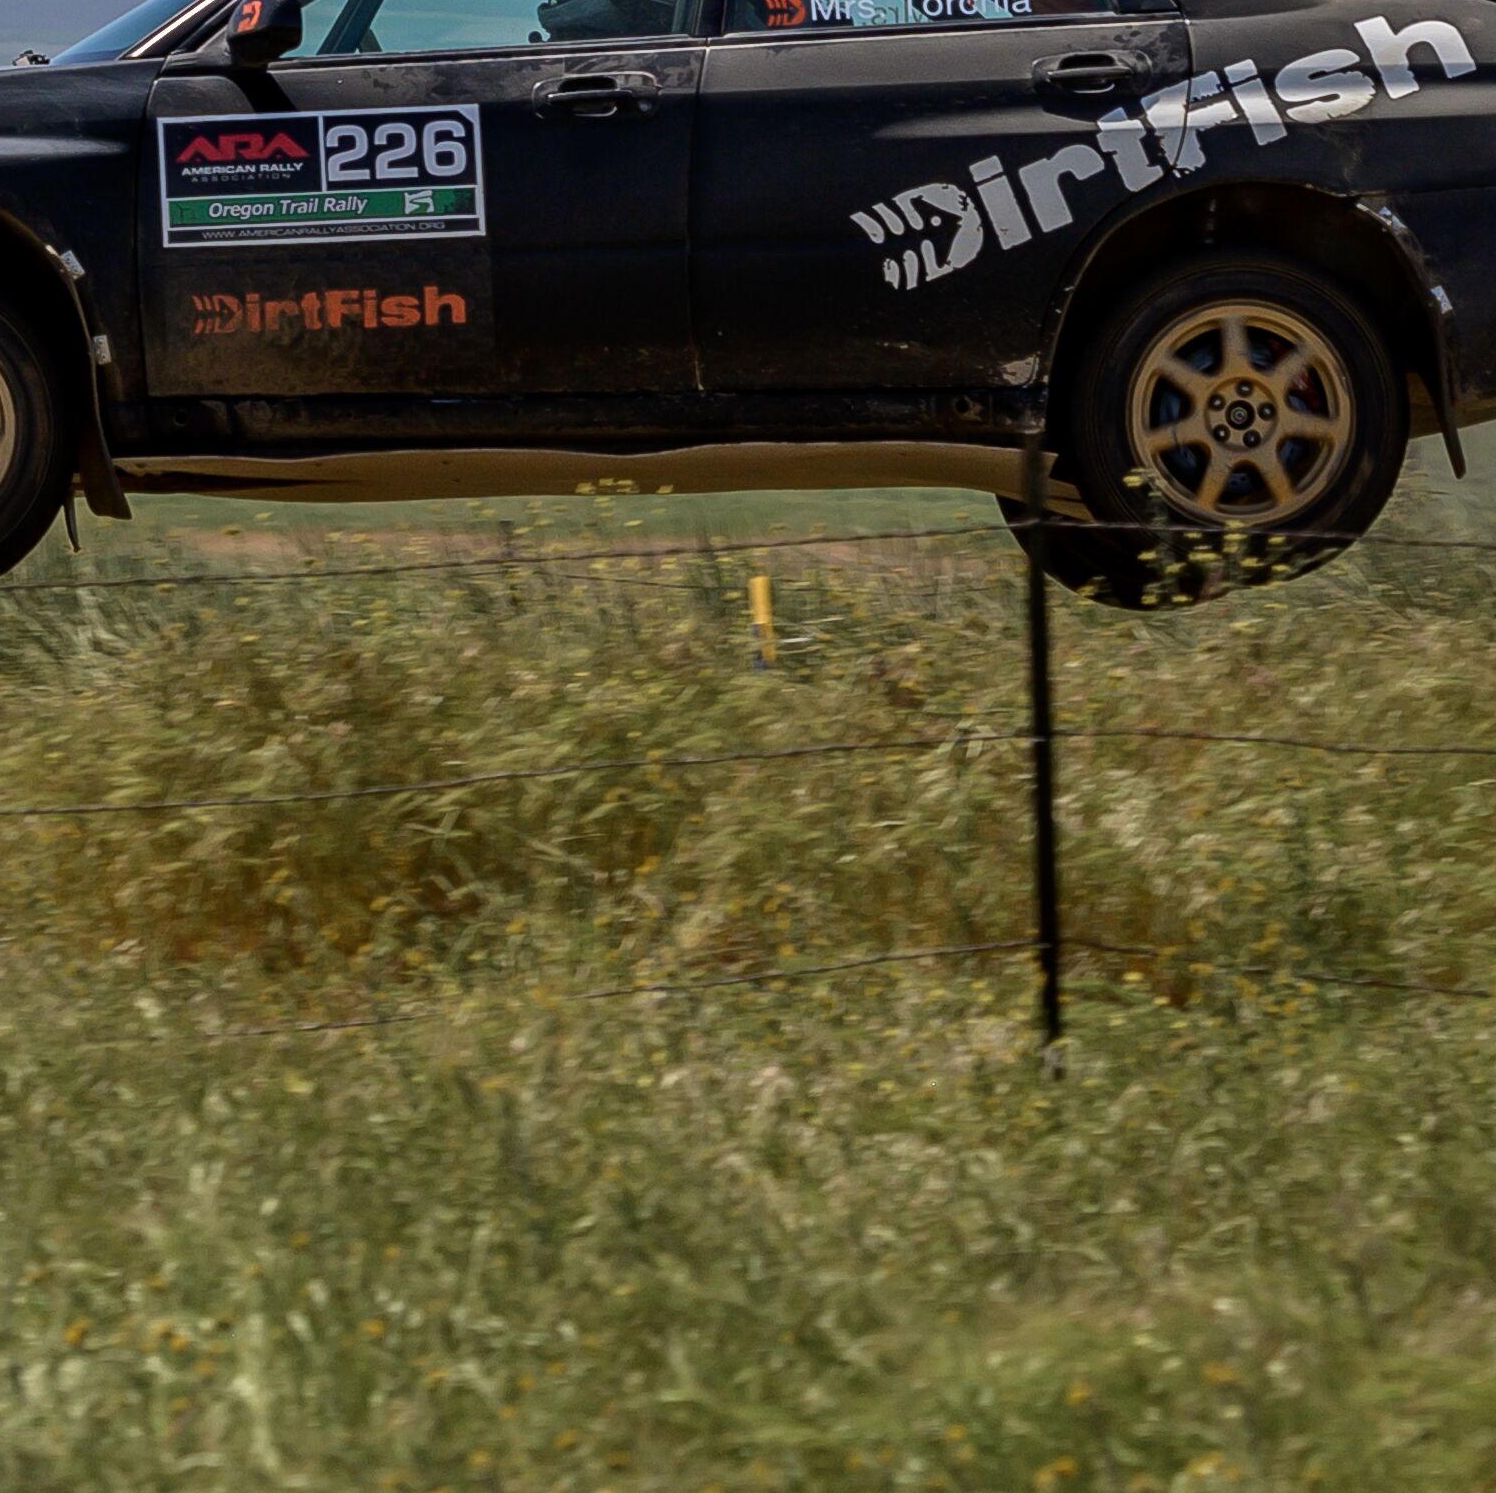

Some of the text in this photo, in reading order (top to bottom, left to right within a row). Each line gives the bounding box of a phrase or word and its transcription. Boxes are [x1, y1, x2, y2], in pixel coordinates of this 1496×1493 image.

[176, 132, 310, 164] ARA
[325, 119, 467, 182] 226
[181, 162, 304, 176] AMERICAN RALLY
[191, 173, 291, 183] ASSOCIATION
[208, 195, 368, 221] Oregon Trail Rally
[191, 286, 468, 334] DirtFish
